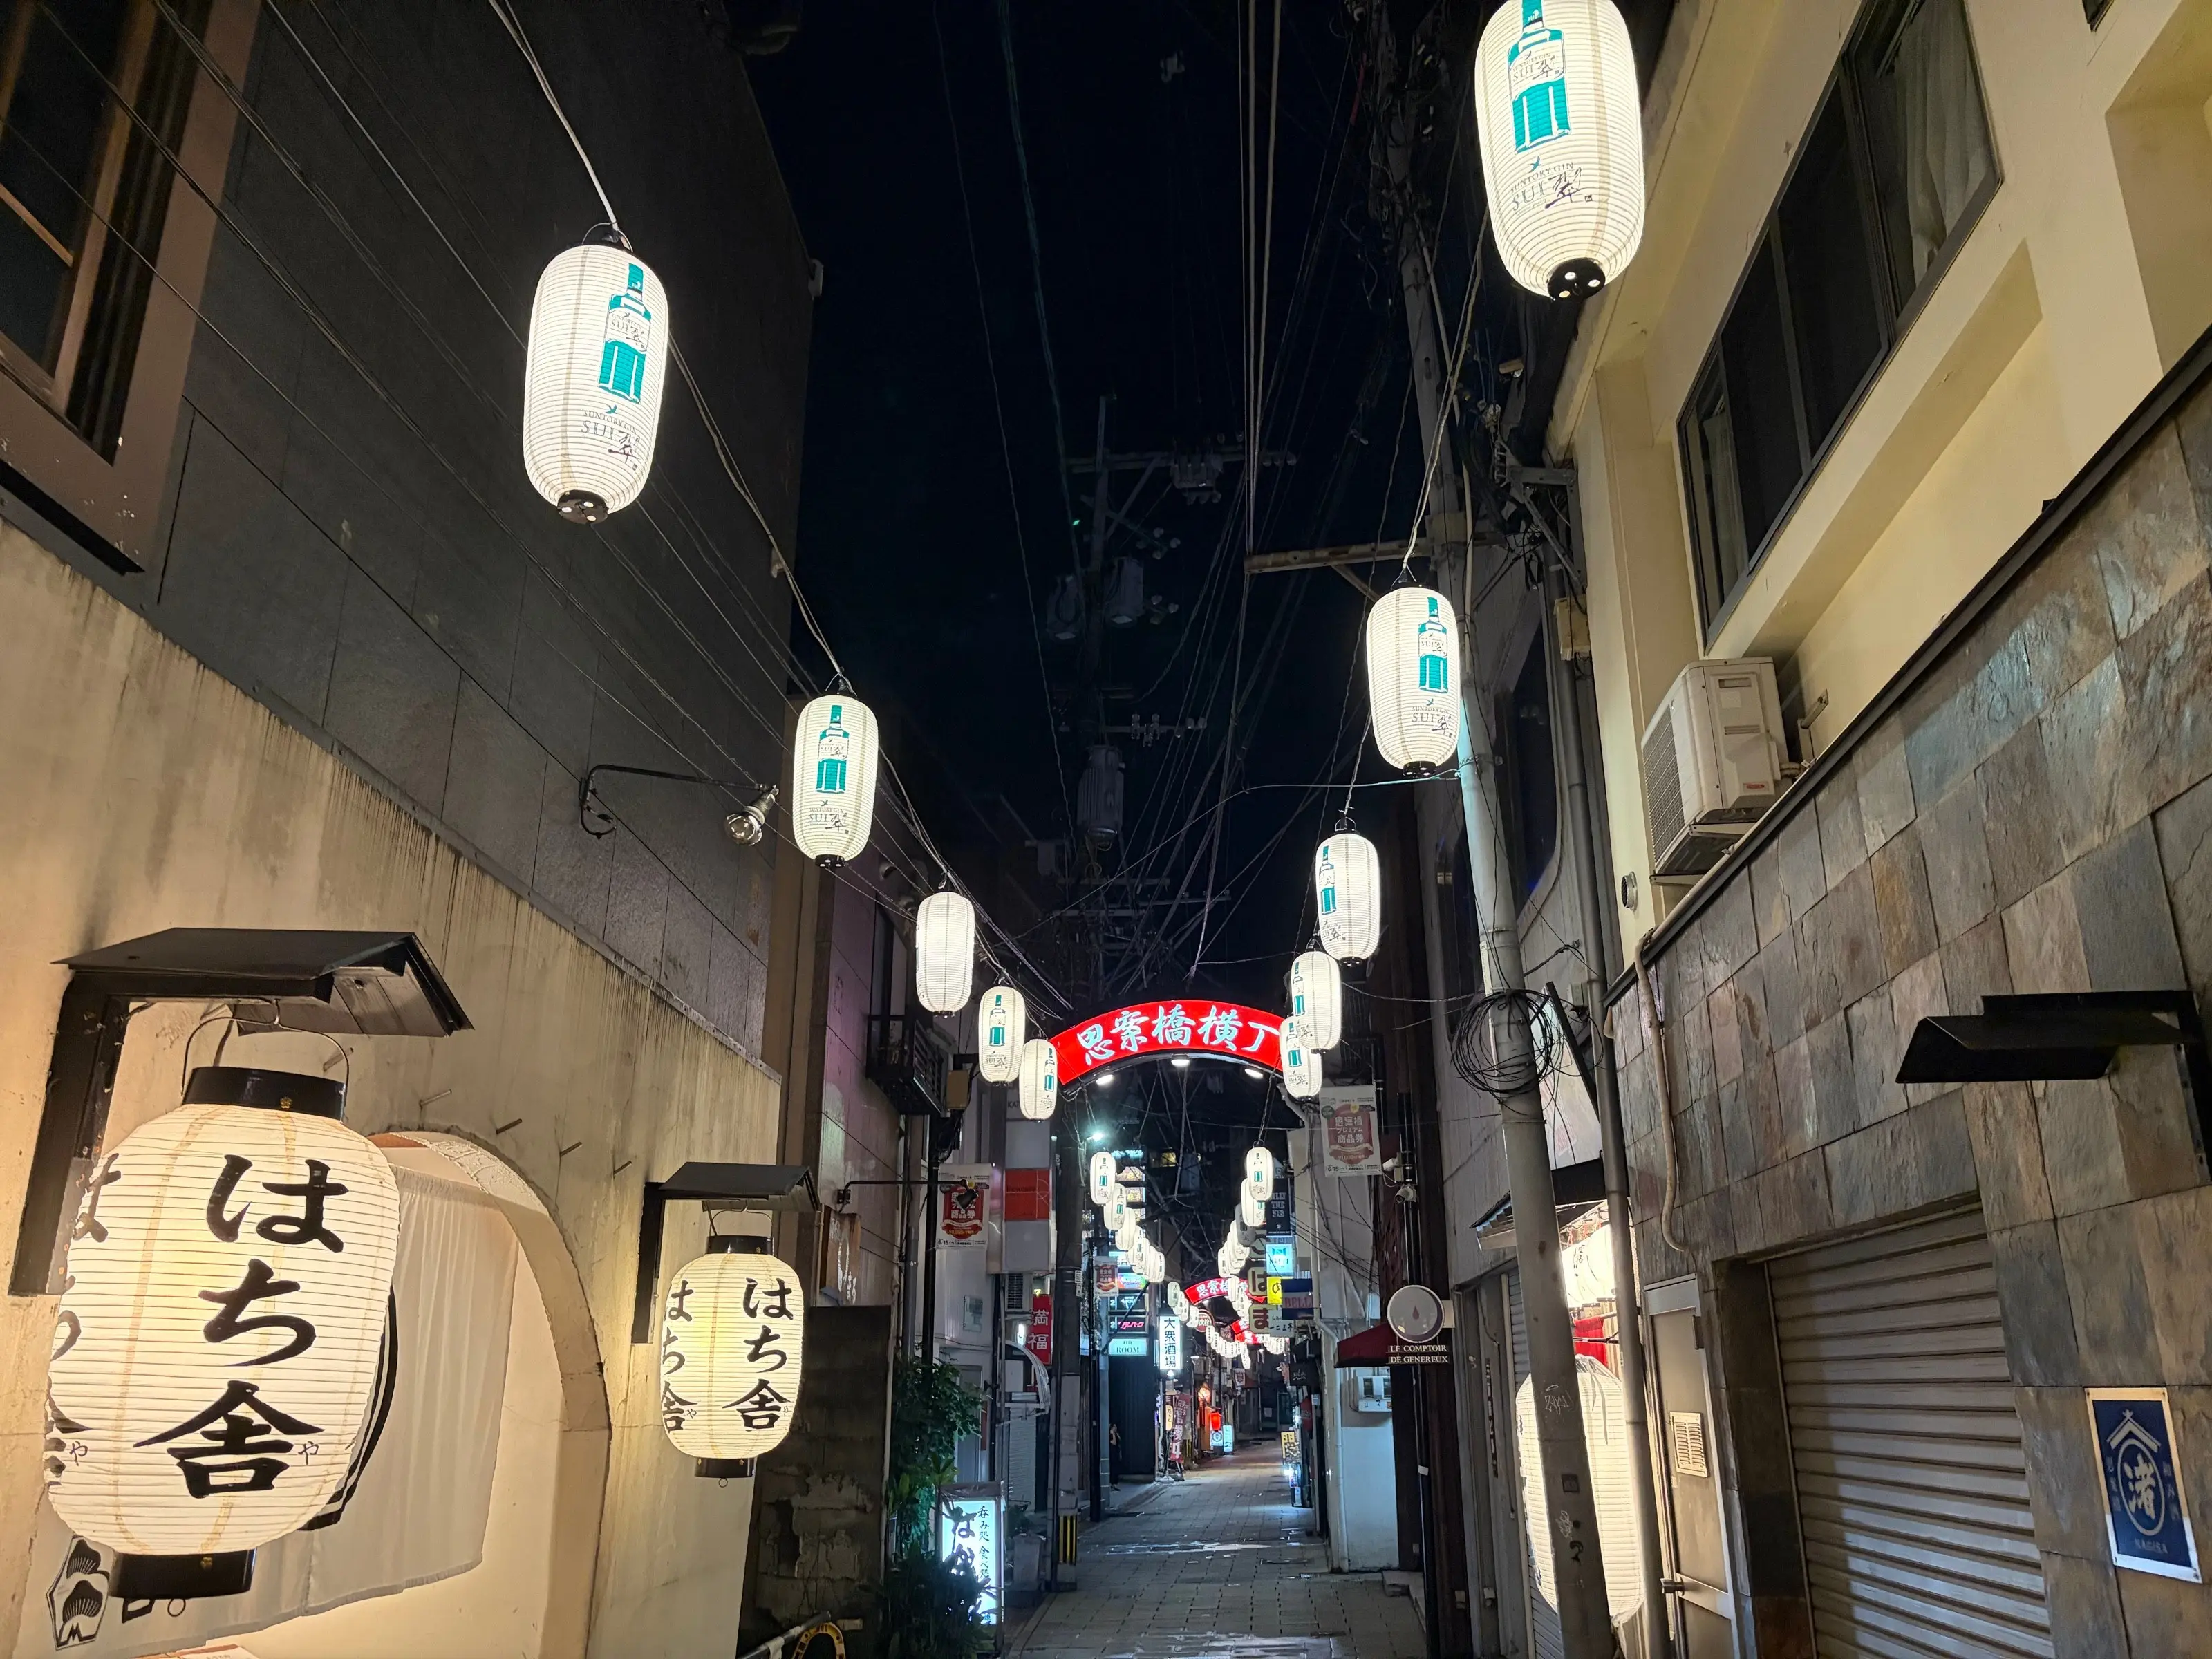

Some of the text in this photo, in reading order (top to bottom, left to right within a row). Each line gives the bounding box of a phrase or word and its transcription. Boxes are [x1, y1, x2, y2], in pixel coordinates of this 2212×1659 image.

[1077, 1004, 1280, 1066] 思案橋横丁
[133, 1154, 350, 1500] はち舎
[1028, 1309, 1050, 1350] 満福
[1163, 1317, 1177, 1368] 大衆酒場
[1403, 1344, 1447, 1353] COMPTOIR
[722, 1277, 794, 1432] はち舎
[1403, 1356, 1449, 1364] GENEREUX
[297, 1439, 321, 1466] や
